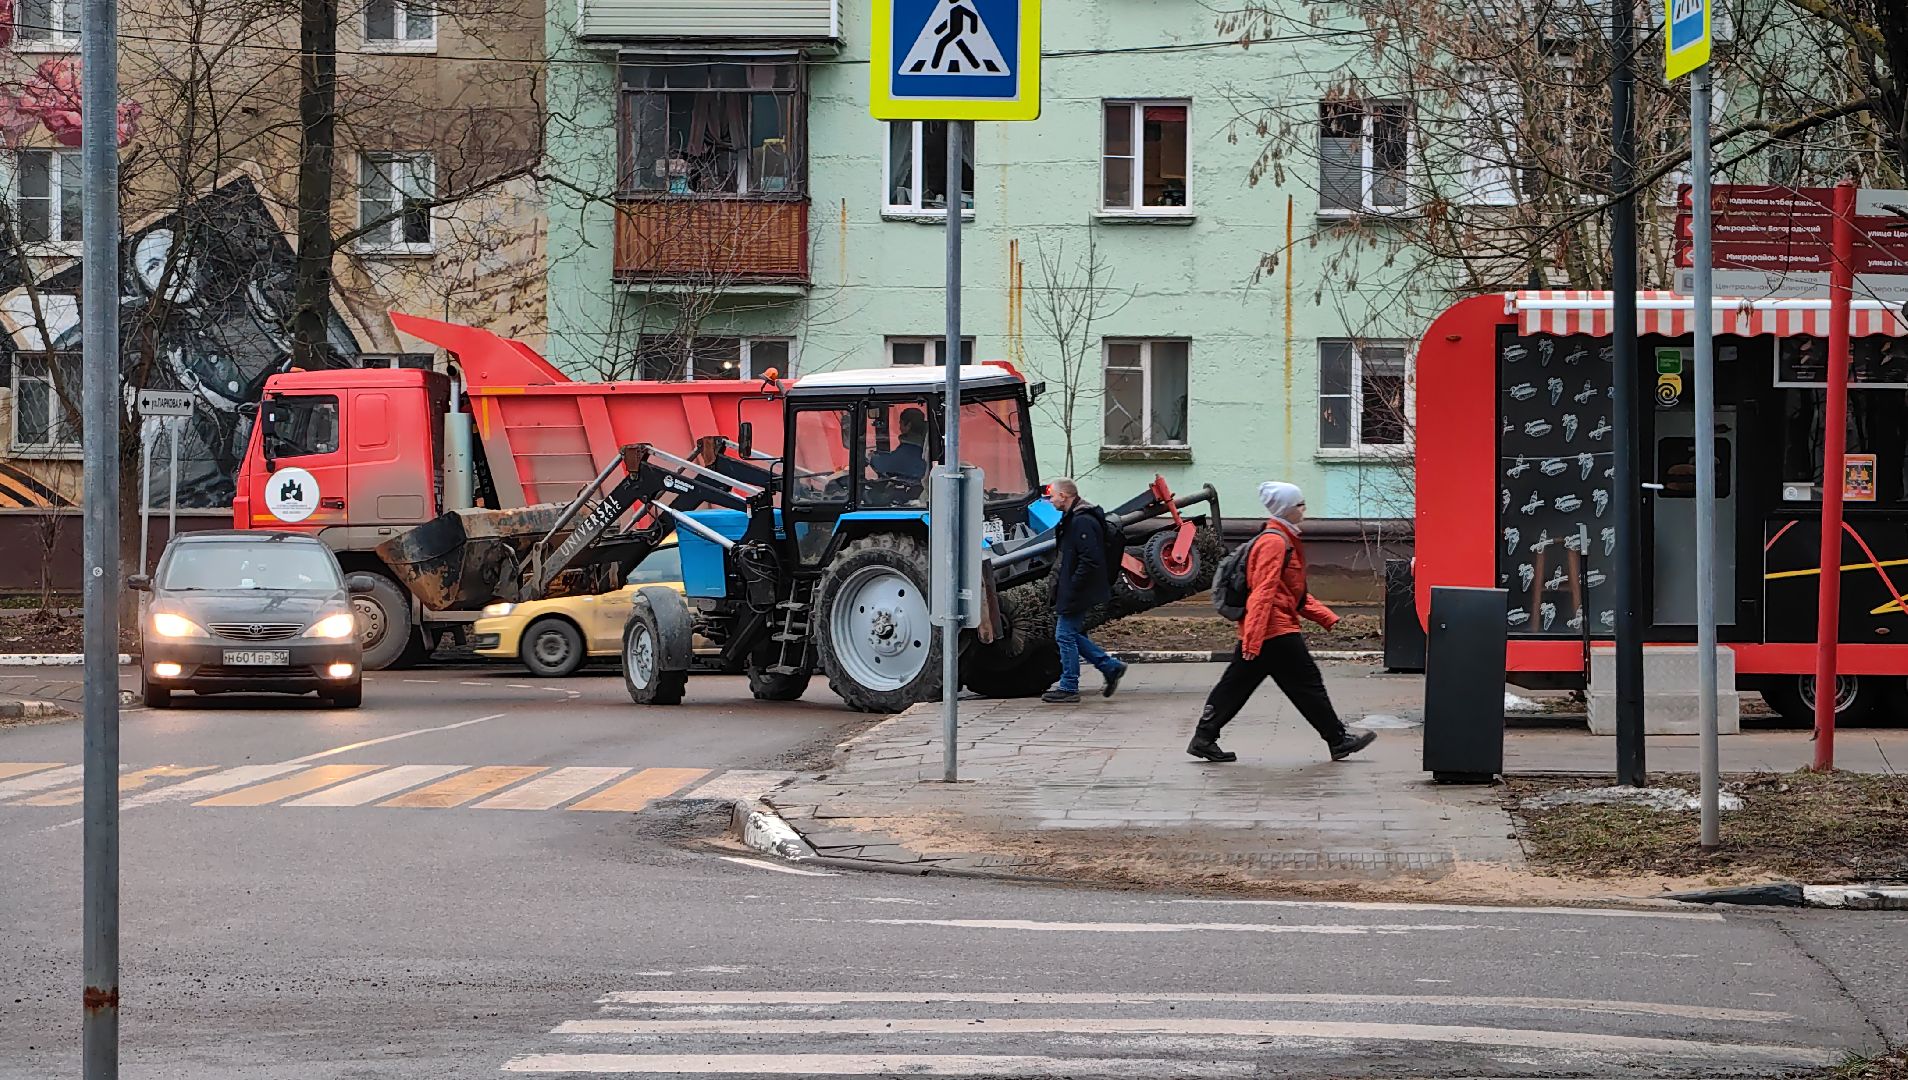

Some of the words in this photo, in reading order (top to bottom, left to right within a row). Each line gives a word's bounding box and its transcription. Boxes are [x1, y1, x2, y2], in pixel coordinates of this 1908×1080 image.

[1867, 230, 1892, 239] улица
[1726, 253, 1778, 263] Микрорайон
[1867, 259, 1893, 267] улица
[600, 503, 622, 529] BASIC
[560, 495, 618, 556] UNIVERSAL
